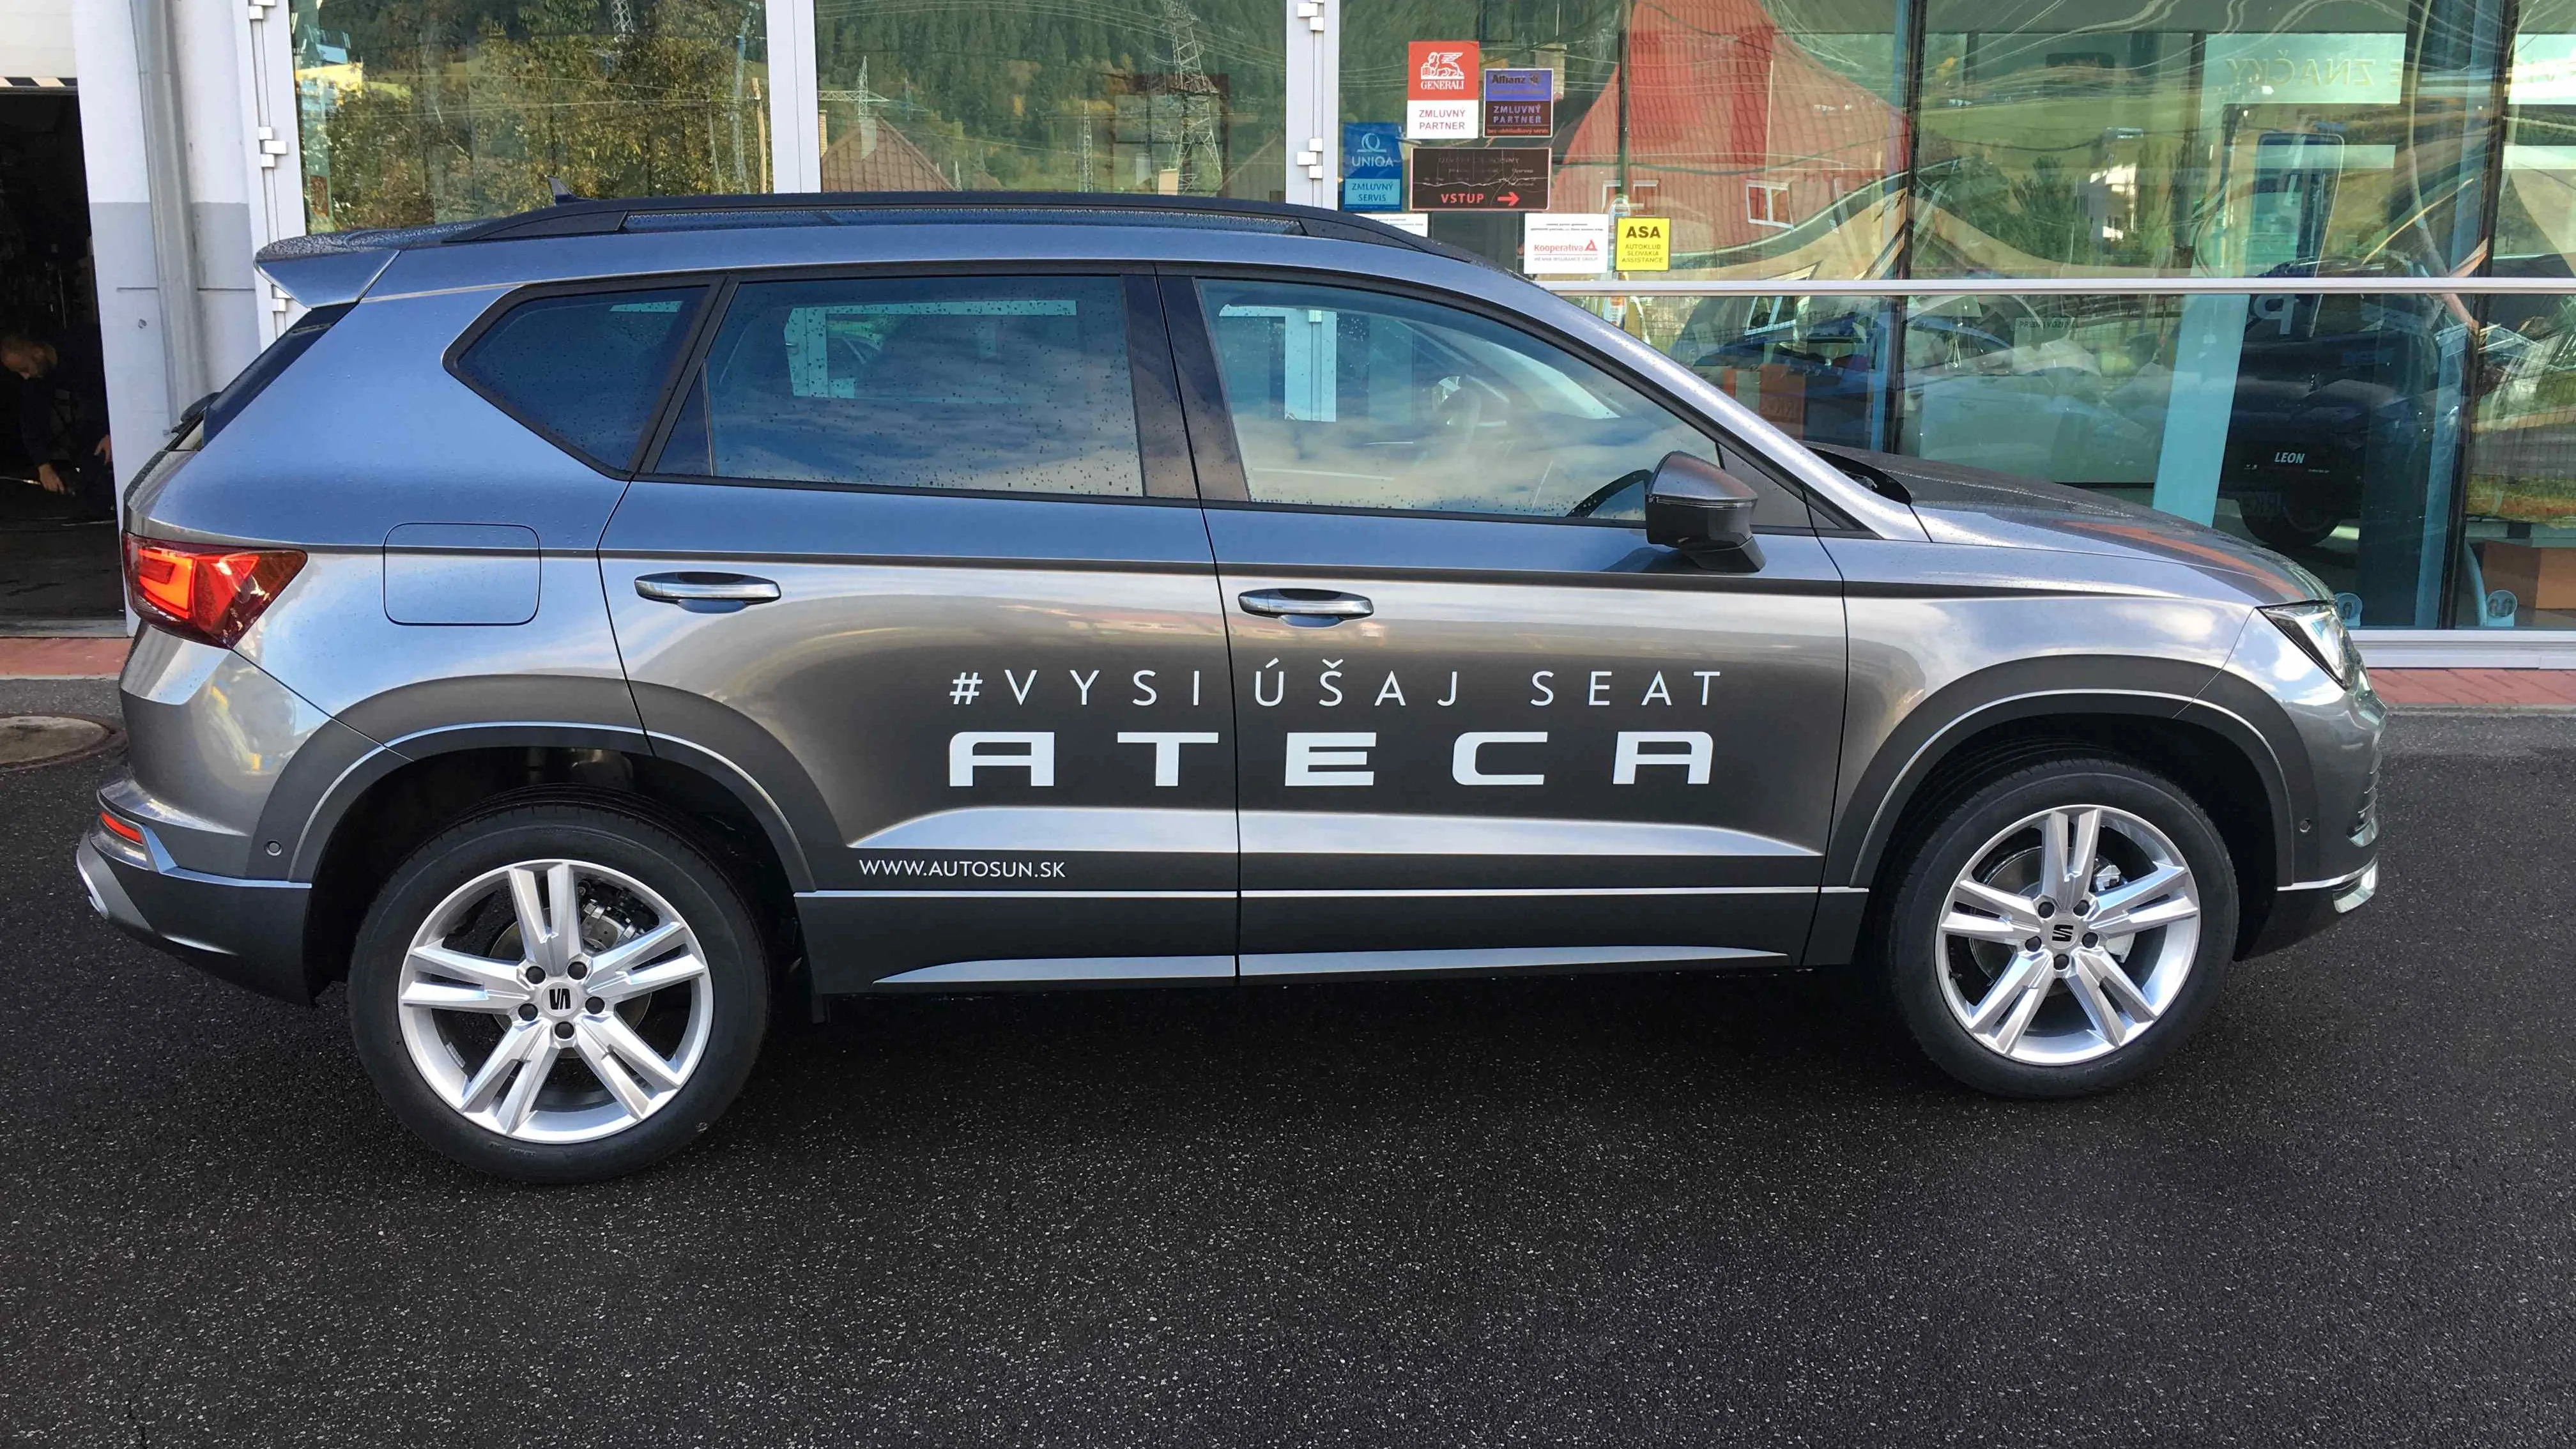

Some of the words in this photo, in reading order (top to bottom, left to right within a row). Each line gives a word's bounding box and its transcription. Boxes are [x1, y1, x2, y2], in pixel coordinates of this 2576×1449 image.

[1492, 74, 1526, 84] Allianz
[1420, 80, 1464, 90] GENERALI
[1419, 107, 1466, 118] ZMLUVNÝ
[1493, 104, 1541, 114] ZMLUVNÝ
[1419, 121, 1465, 130] PARTNER
[1351, 183, 1393, 191] ZMLUVNÝ
[1358, 194, 1386, 202] SERVIS
[1441, 193, 1484, 204] VSTUP
[1625, 226, 1661, 238] ASA
[1534, 244, 1584, 253] Kooperativa
[2274, 452, 2305, 464] LEON
[1530, 671, 1721, 706] SEAT
[949, 731, 1714, 787] ATECA
[859, 859, 1066, 878] WWW.AUTOSUN.SK
